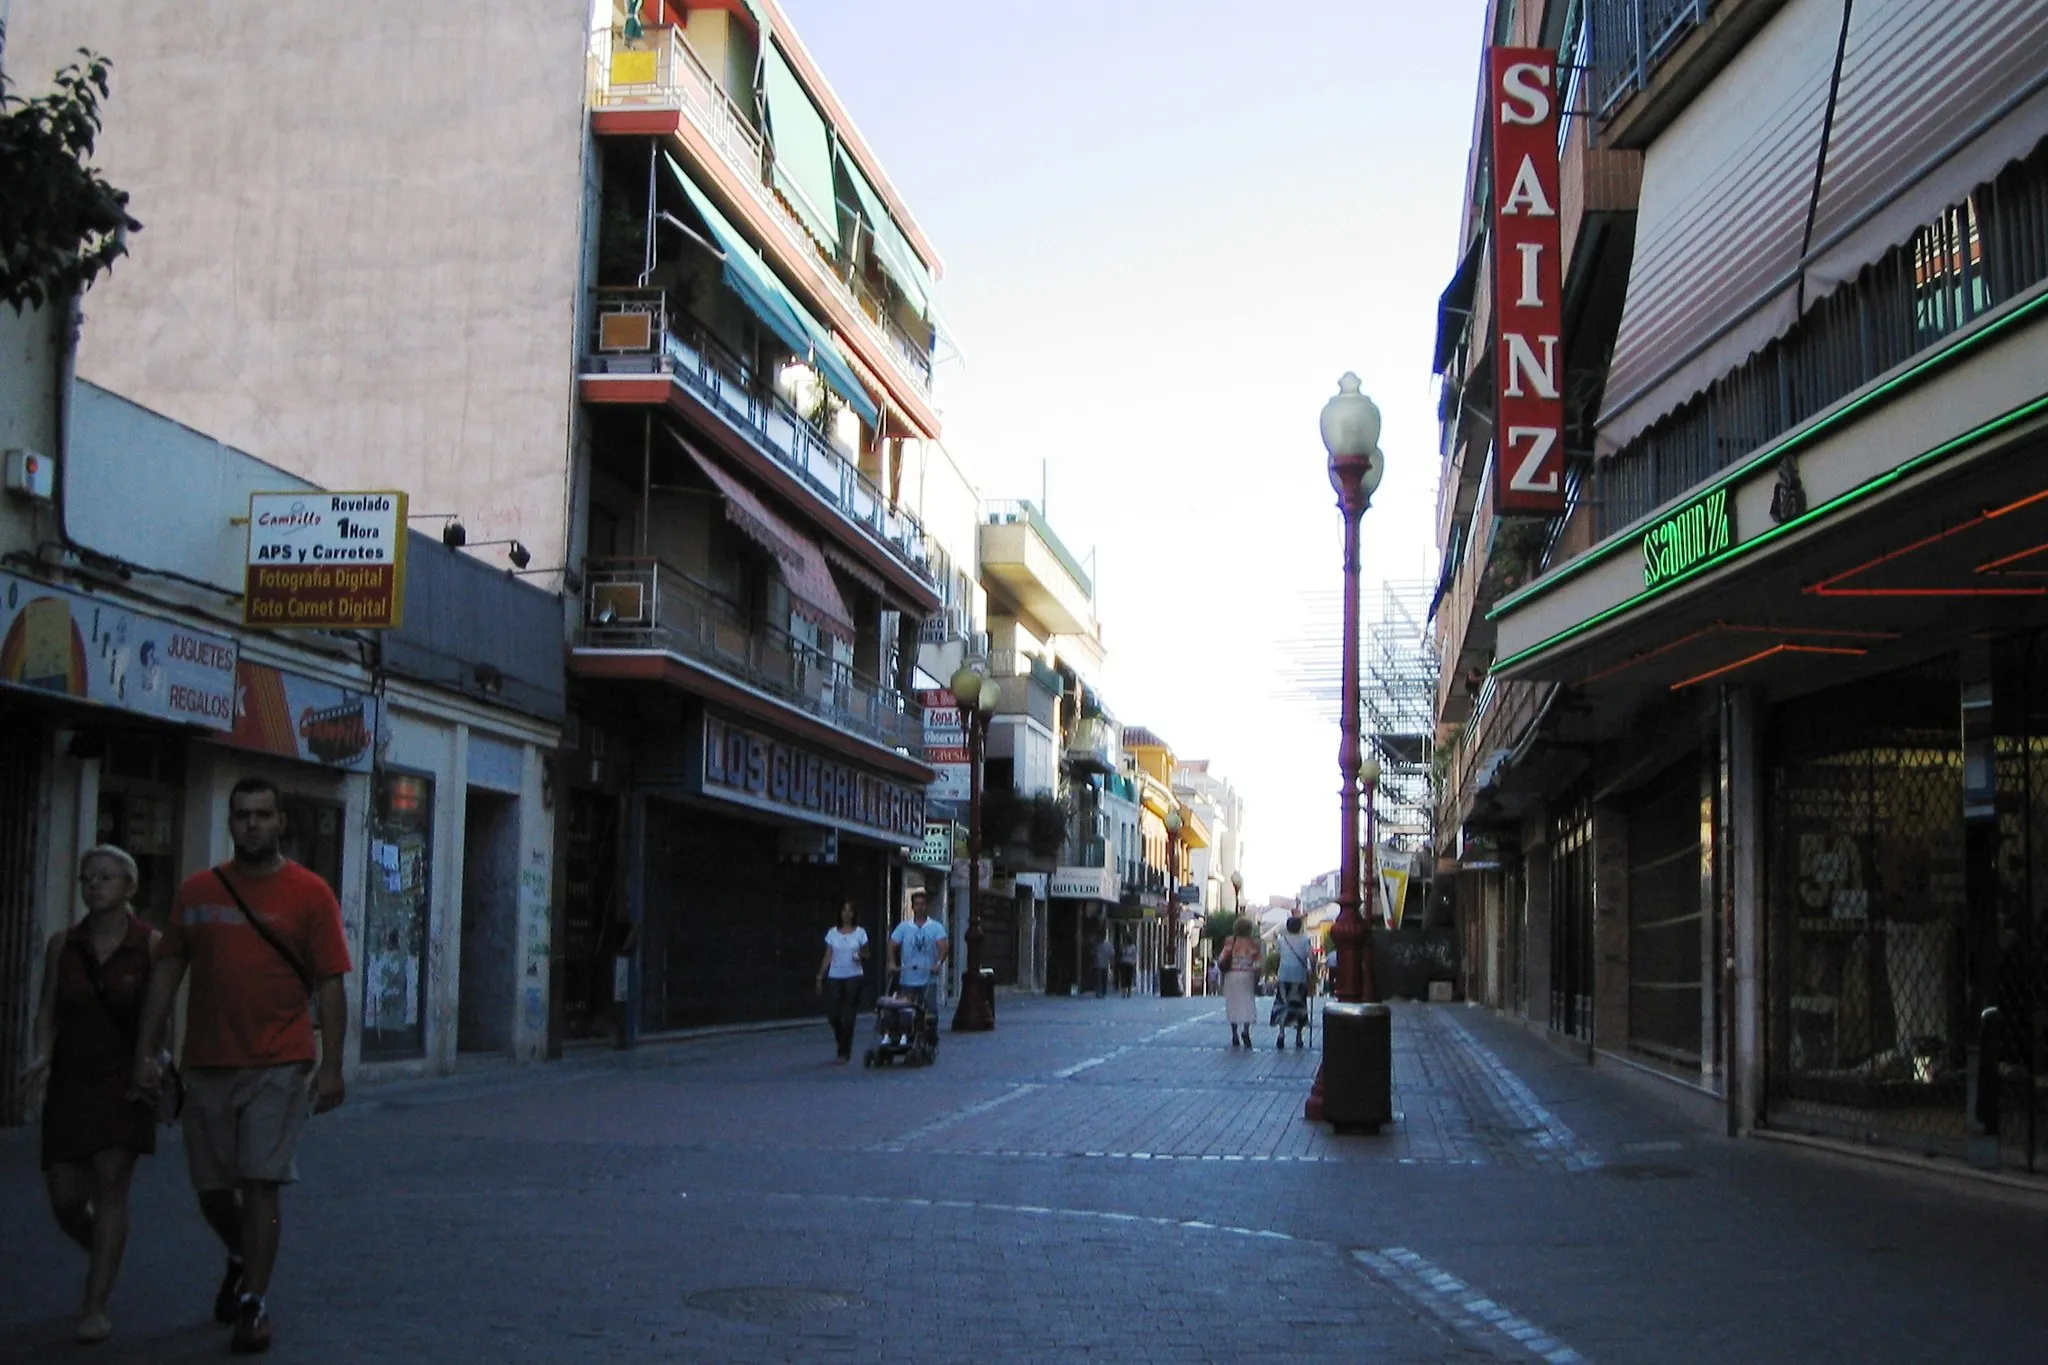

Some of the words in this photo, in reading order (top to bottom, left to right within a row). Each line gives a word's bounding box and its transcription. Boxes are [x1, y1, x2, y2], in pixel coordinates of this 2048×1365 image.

[1500, 63, 1560, 494] SAINZ
[331, 496, 390, 512] Revelado
[258, 511, 321, 528] Campillo
[258, 545, 292, 559] APS
[298, 549, 307, 563] y
[313, 544, 384, 559] Carretes
[335, 567, 383, 592] Digital
[253, 598, 283, 617] Foto
[288, 598, 333, 617] Carnet
[339, 597, 386, 621] Digital
[167, 633, 234, 673] JUGUETES
[168, 684, 230, 720] REGALOS
[706, 715, 768, 798] LOS
